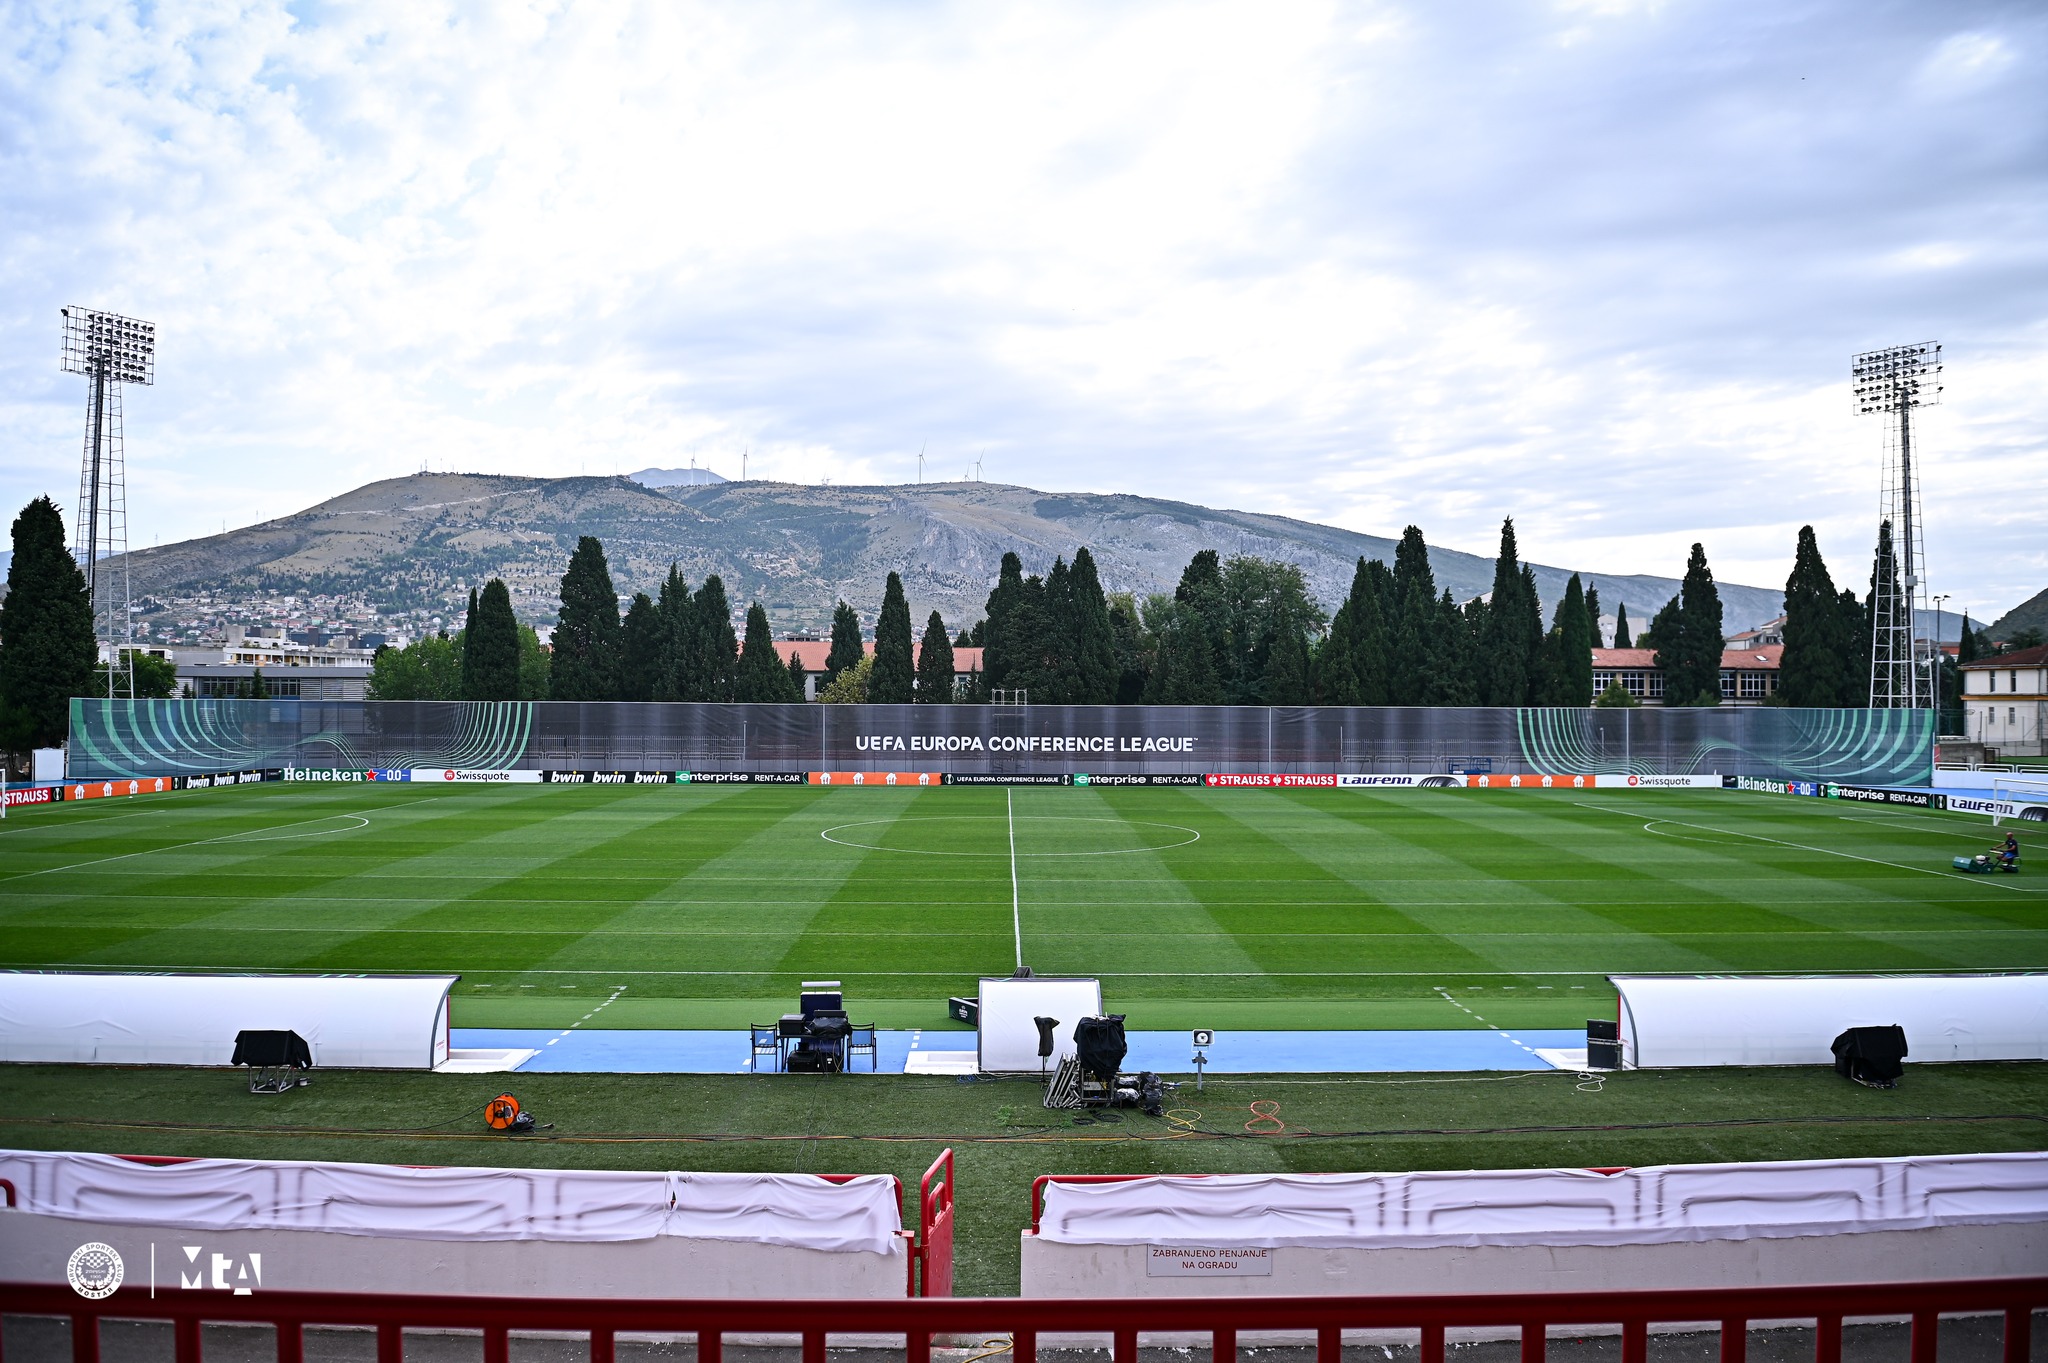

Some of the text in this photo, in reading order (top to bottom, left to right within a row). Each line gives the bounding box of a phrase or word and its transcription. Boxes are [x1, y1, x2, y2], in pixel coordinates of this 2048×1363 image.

[856, 736, 905, 750] UEFA
[911, 736, 984, 751] EUROPA
[988, 737, 1114, 752] CONFERENCE
[186, 769, 261, 789] bwin bwin bwin
[283, 767, 362, 781] Heineken
[456, 771, 510, 782] Swissquote
[551, 770, 668, 784] bwin bwin bwin
[678, 772, 749, 784] enterprise
[1077, 774, 1147, 786] enterprise
[1220, 775, 1334, 786] STRAUSS STRAUSS
[1639, 776, 1691, 787] Swissquote
[1737, 775, 1785, 794] Heineken
[5, 789, 49, 805] STRAUSS
[1828, 786, 1885, 801] enterprise
[1152, 1249, 1267, 1258] ZABRANJENO PENJANJE
[1182, 1261, 1238, 1269] NA OGRADU
